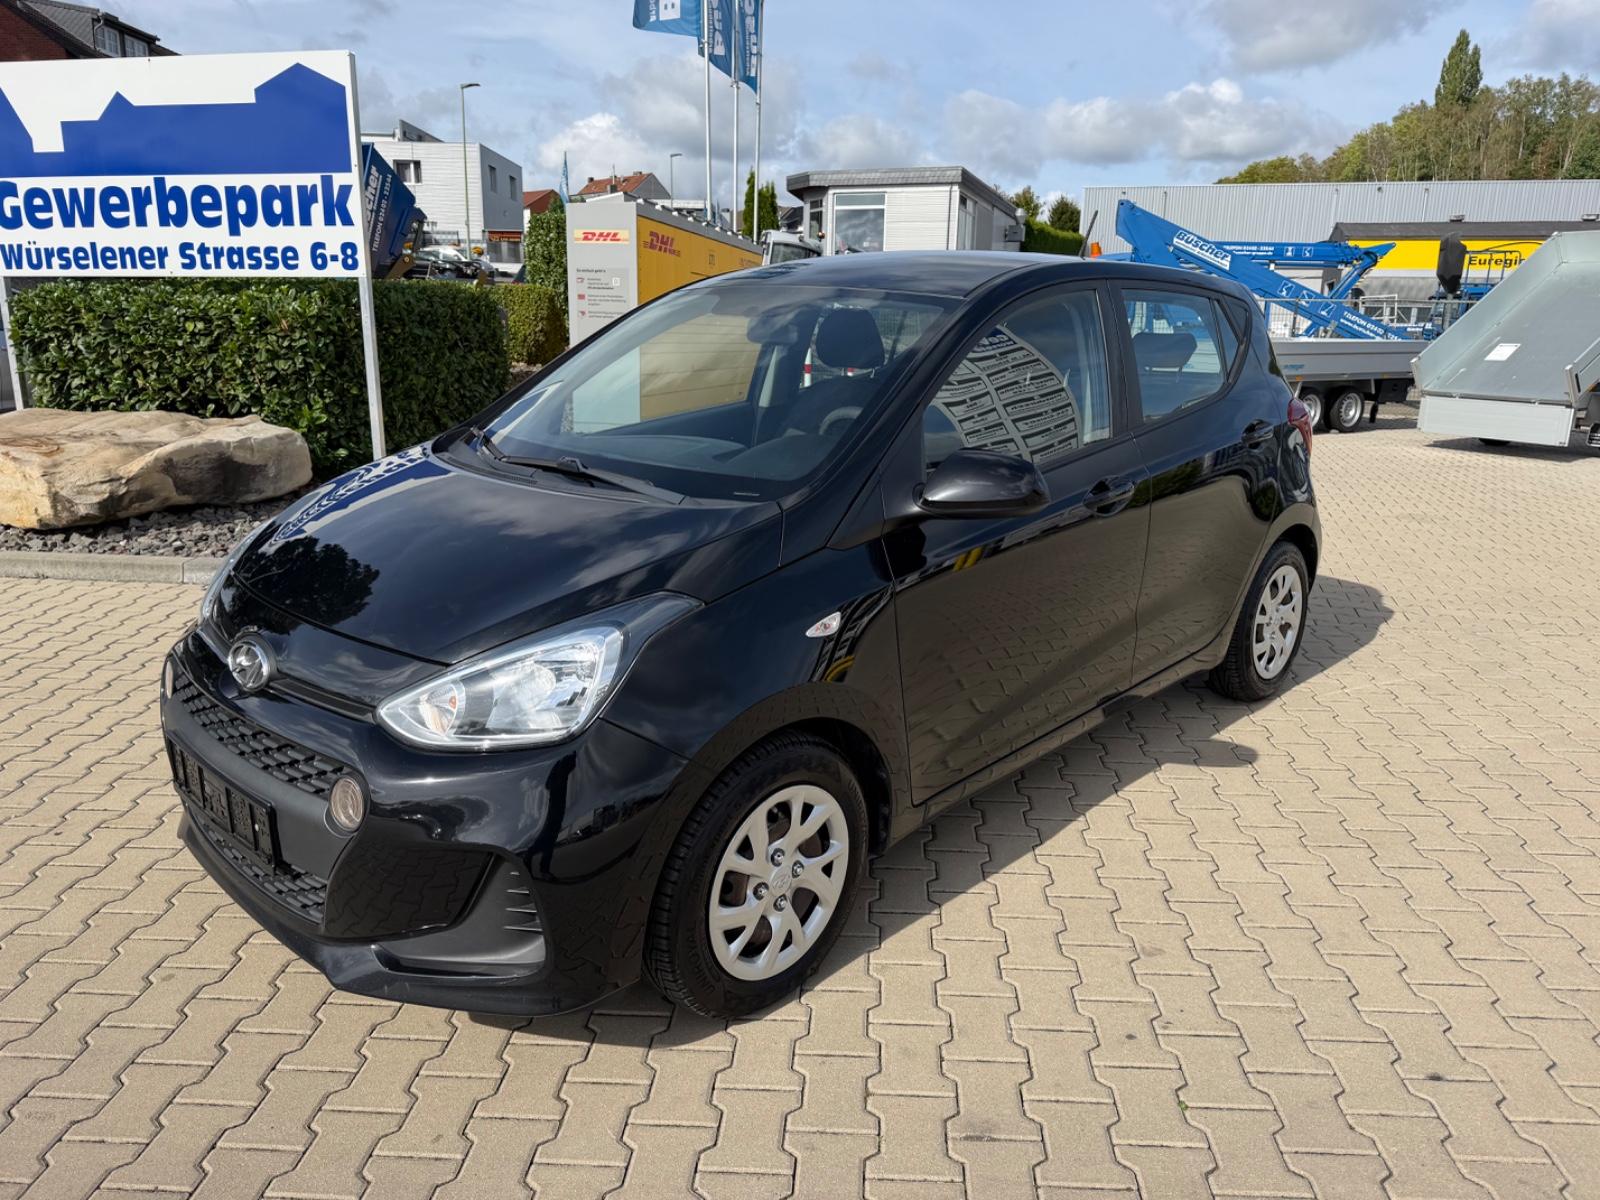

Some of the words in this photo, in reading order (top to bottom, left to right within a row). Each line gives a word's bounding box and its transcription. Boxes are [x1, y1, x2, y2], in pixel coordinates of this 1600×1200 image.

[0, 175, 355, 237] Gewerbepark
[372, 221, 384, 252] TELEFON
[583, 231, 621, 242] DHL
[648, 231, 677, 255] DHL
[1, 241, 169, 271] Würselener
[180, 241, 299, 271] Strasse
[310, 241, 359, 271] 6-8
